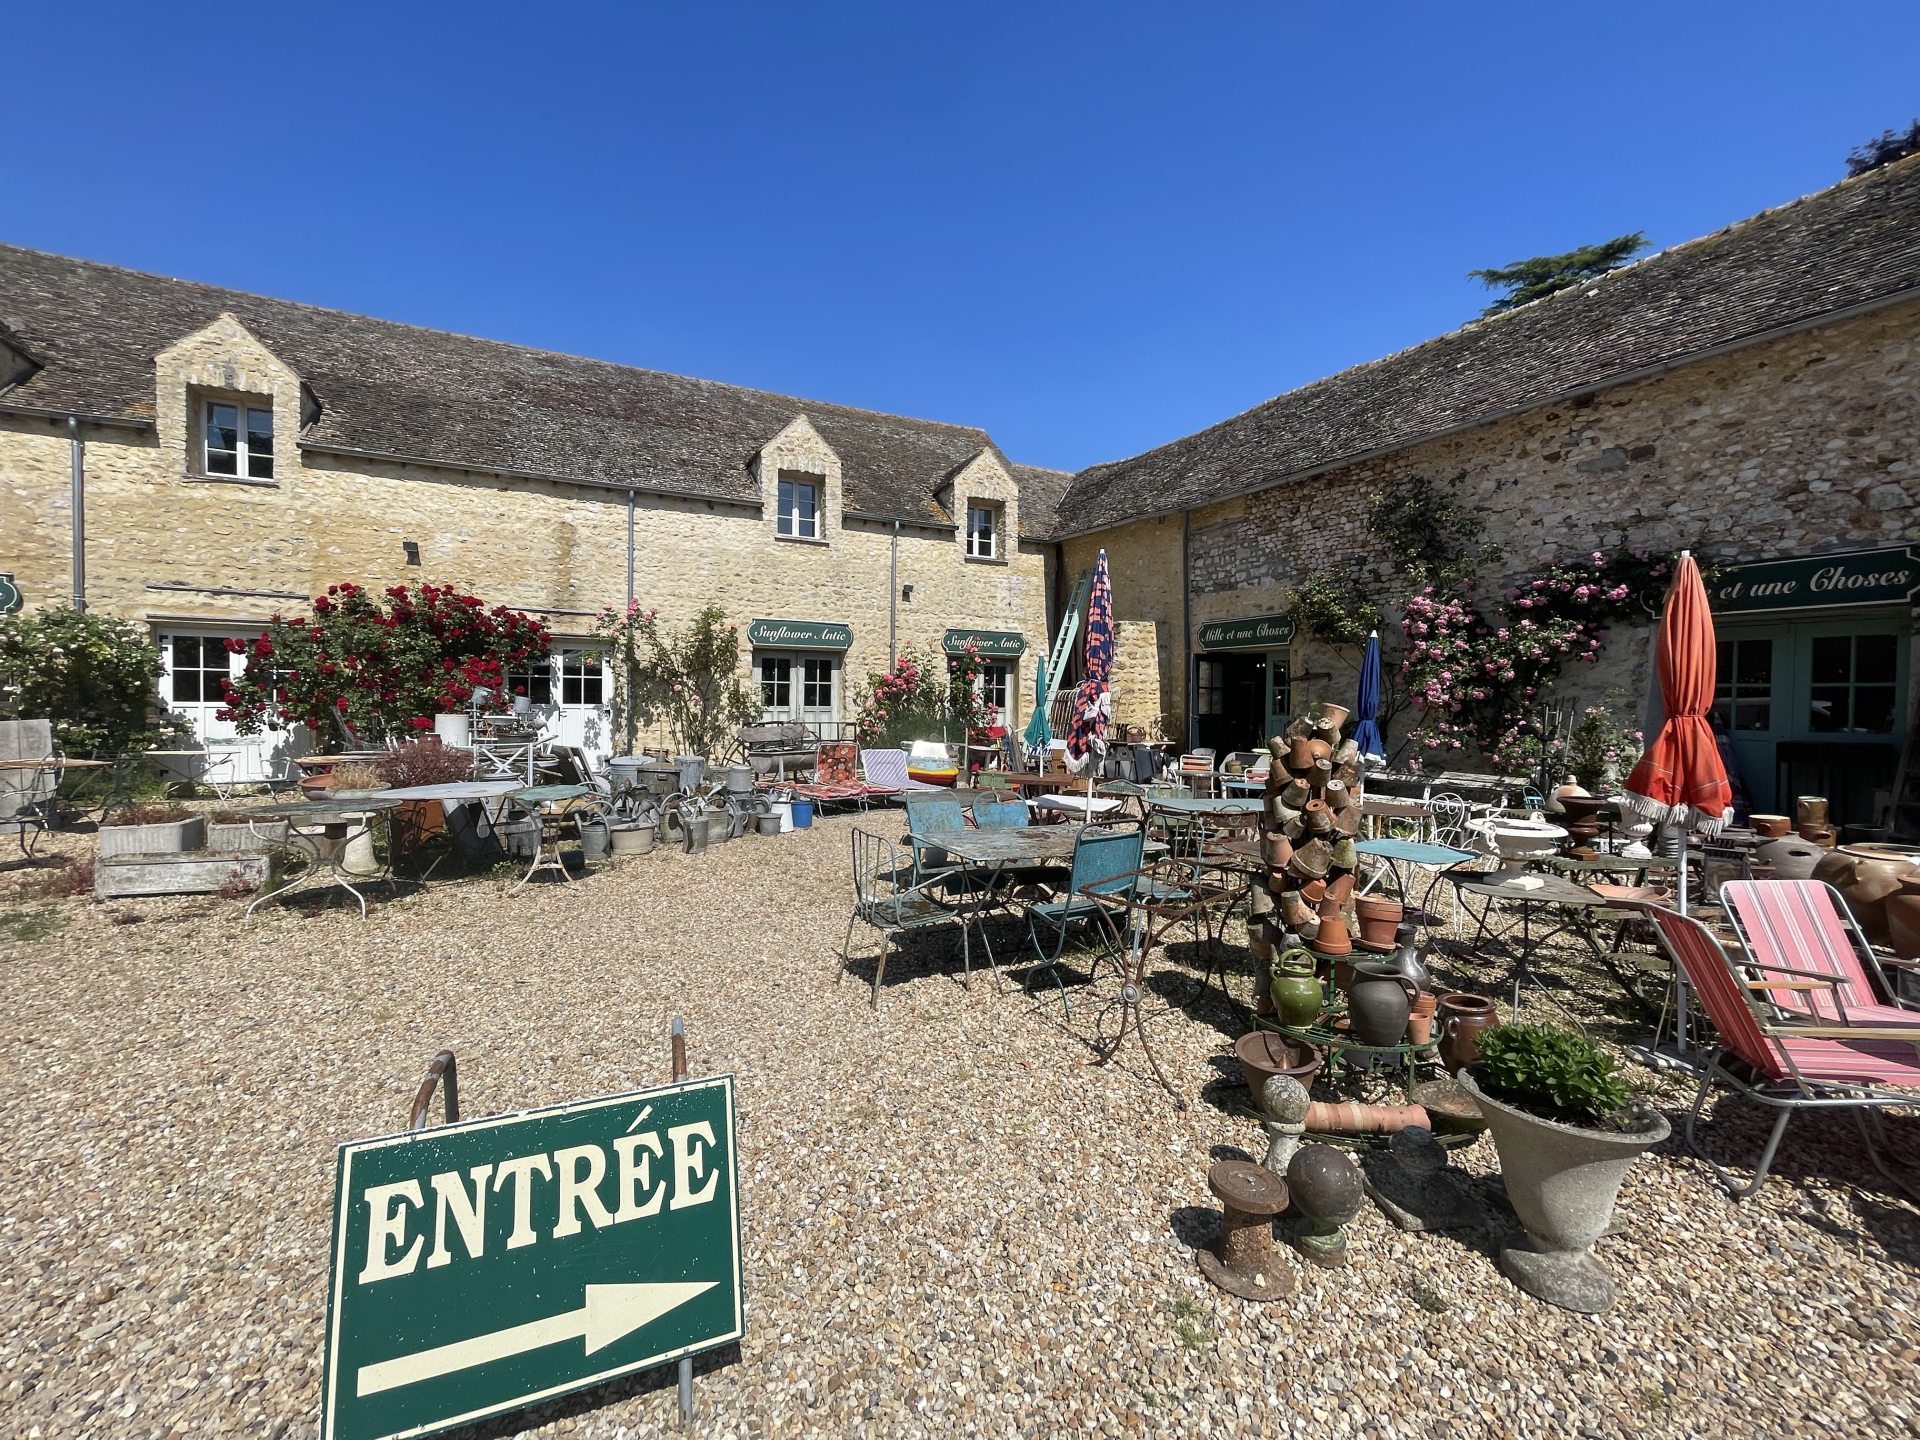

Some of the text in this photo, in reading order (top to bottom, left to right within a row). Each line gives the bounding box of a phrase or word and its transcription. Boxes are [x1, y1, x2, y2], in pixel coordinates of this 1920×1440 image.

[1720, 582, 1744, 599] et
[1750, 578, 1799, 597] une
[1809, 566, 1912, 592] Choses
[755, 625, 846, 641] Sunflower Antic
[1201, 622, 1290, 642] Mille et une Choses
[994, 637, 1021, 648] Antic
[358, 1104, 720, 1285] ENTRÉE
